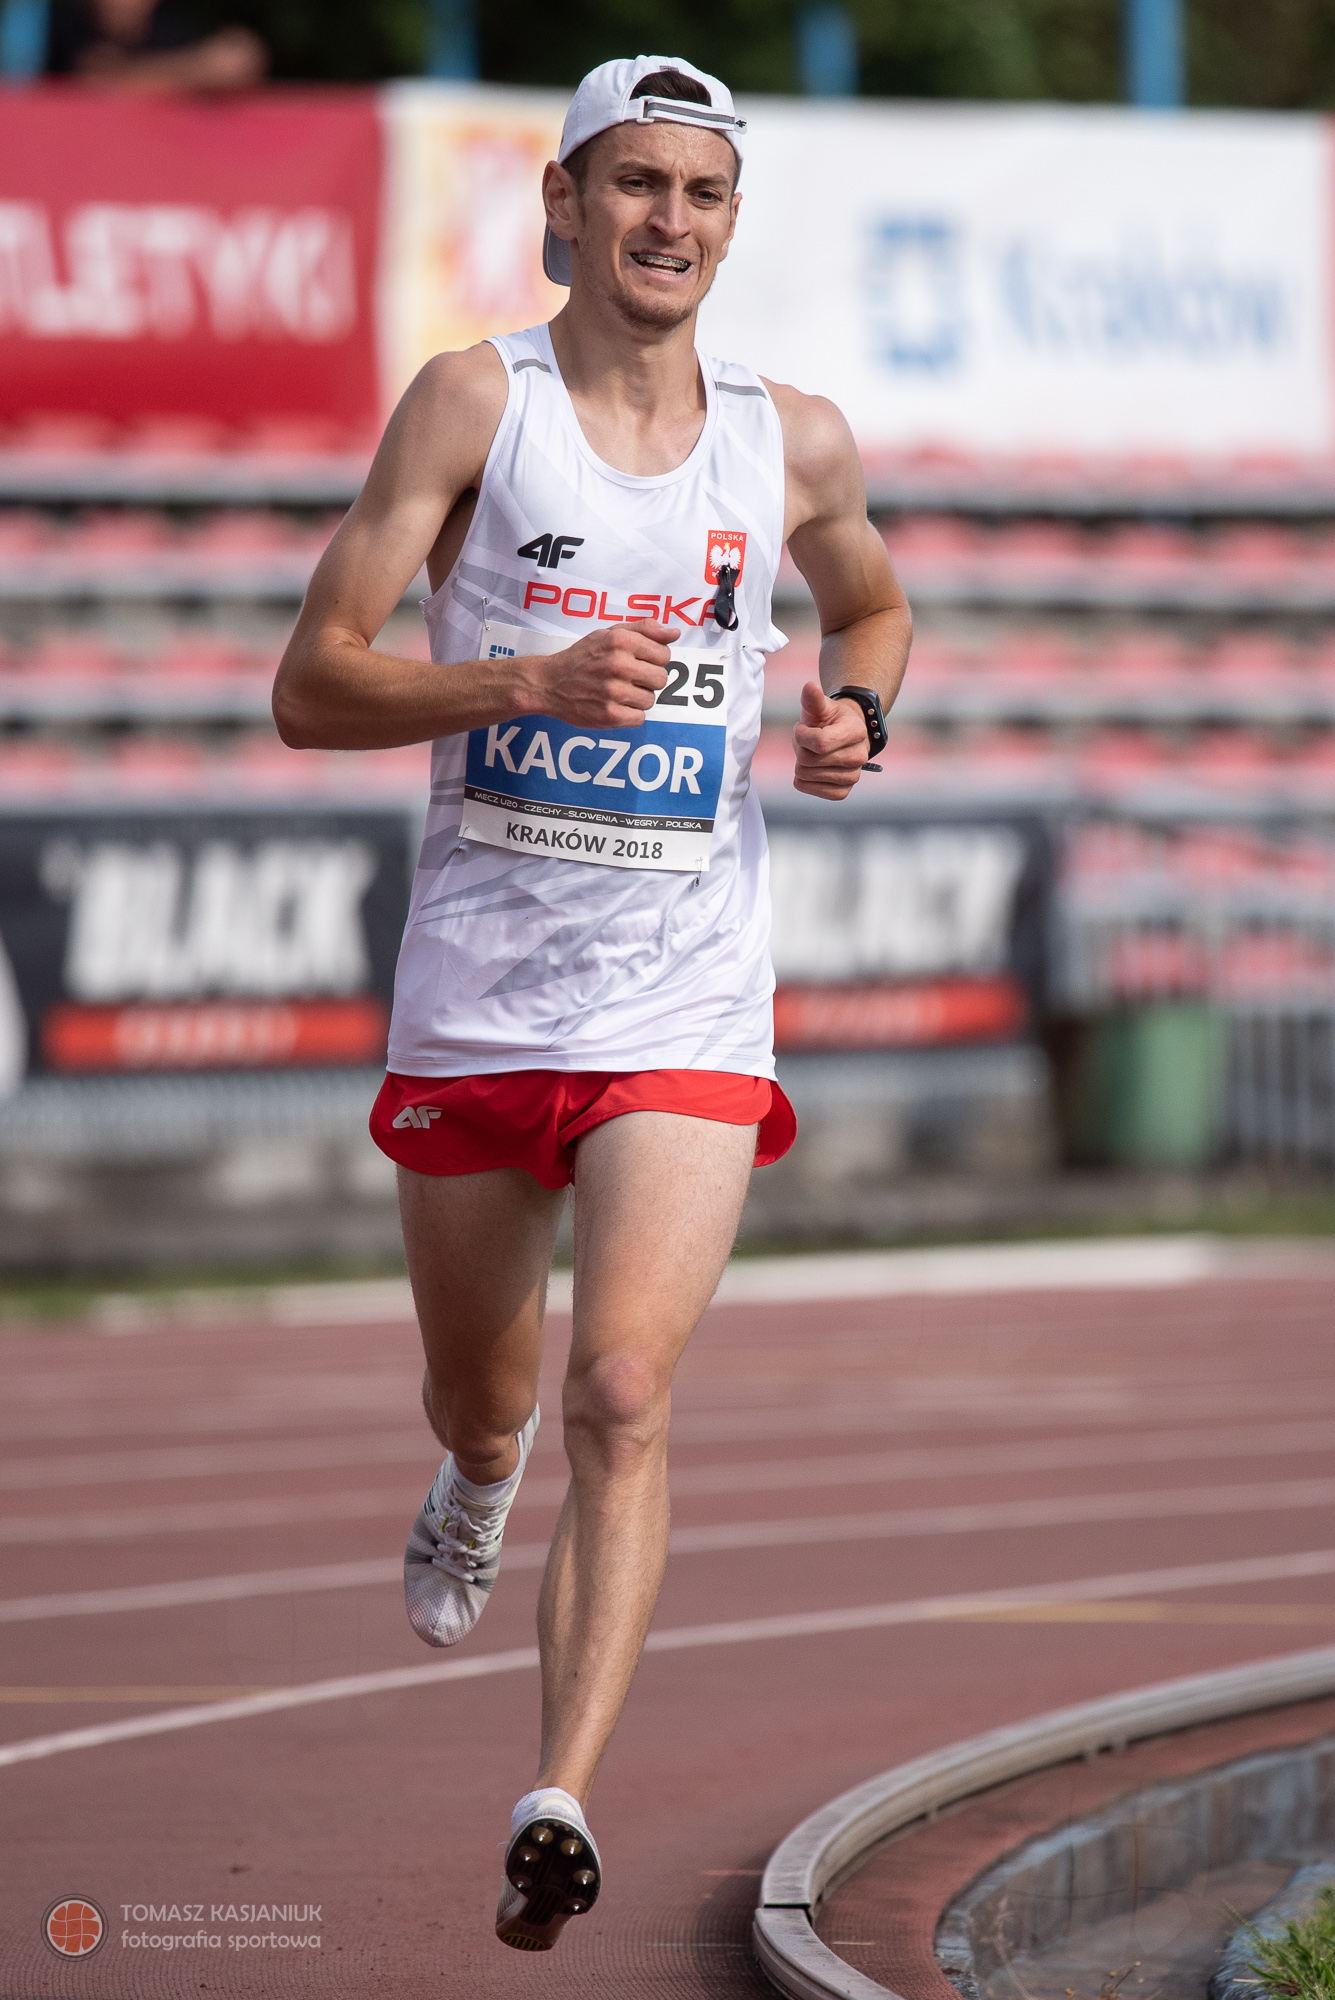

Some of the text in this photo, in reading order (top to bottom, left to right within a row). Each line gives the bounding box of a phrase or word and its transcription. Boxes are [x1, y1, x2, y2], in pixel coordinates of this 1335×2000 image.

[517, 533, 585, 569] 4F
[711, 532, 744, 542] POLSKA
[656, 661, 725, 709] 25
[484, 725, 704, 795] KACZOR
[474, 791, 499, 804] MECZ
[500, 798, 518, 809] U20
[665, 820, 702, 830] POLSKA
[506, 822, 664, 860] KRAKÓW 2018
[392, 1106, 443, 1129] 4F
